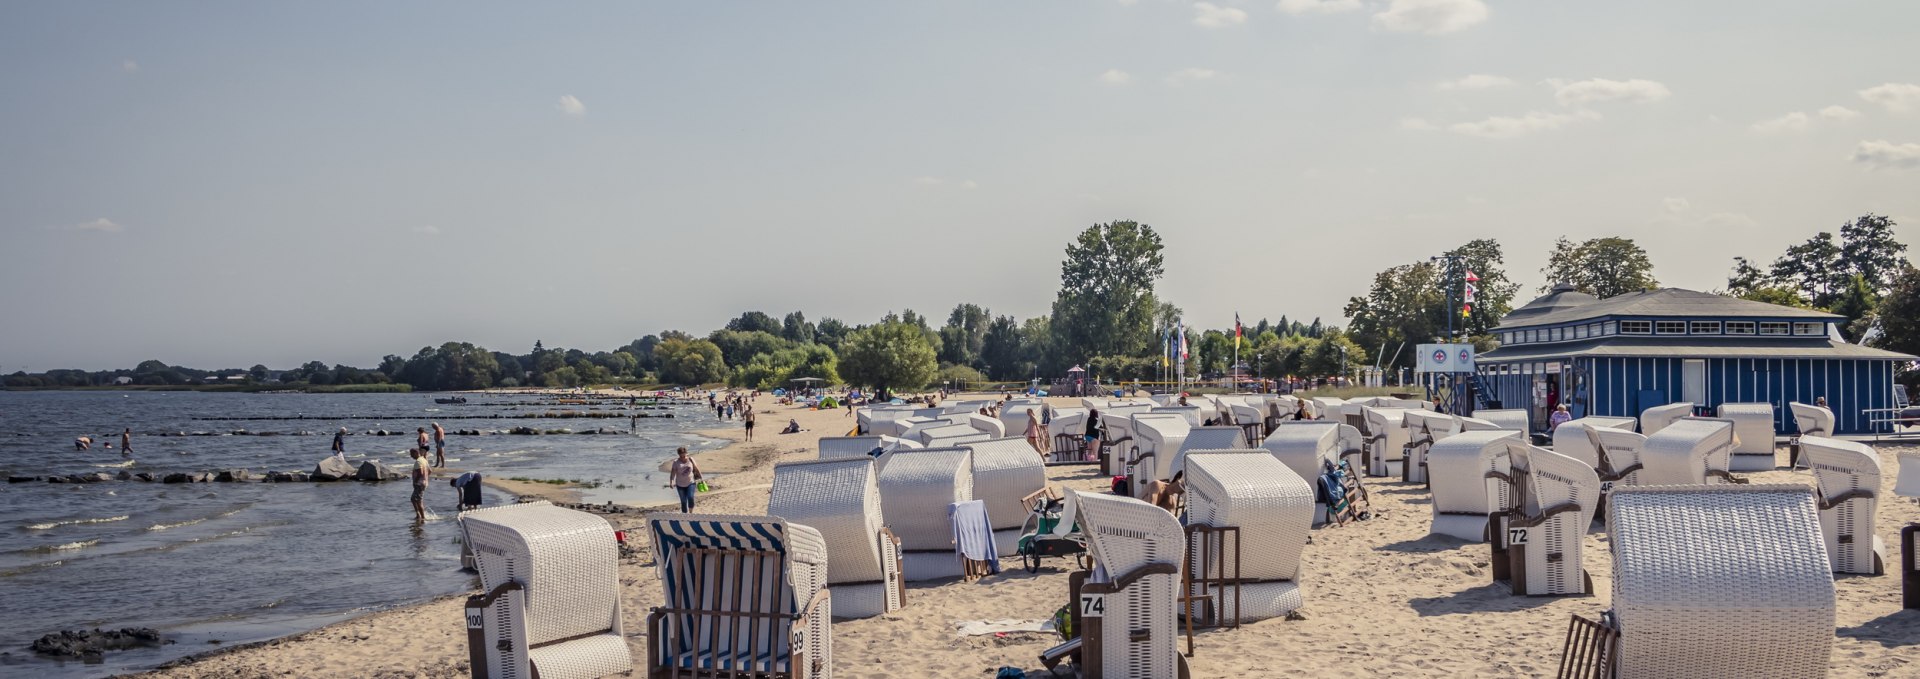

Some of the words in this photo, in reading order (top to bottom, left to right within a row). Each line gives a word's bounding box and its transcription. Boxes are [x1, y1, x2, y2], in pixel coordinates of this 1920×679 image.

[1511, 529, 1527, 543] 72
[1082, 597, 1104, 615] 74
[468, 615, 482, 626] 100
[793, 631, 804, 651] 99
